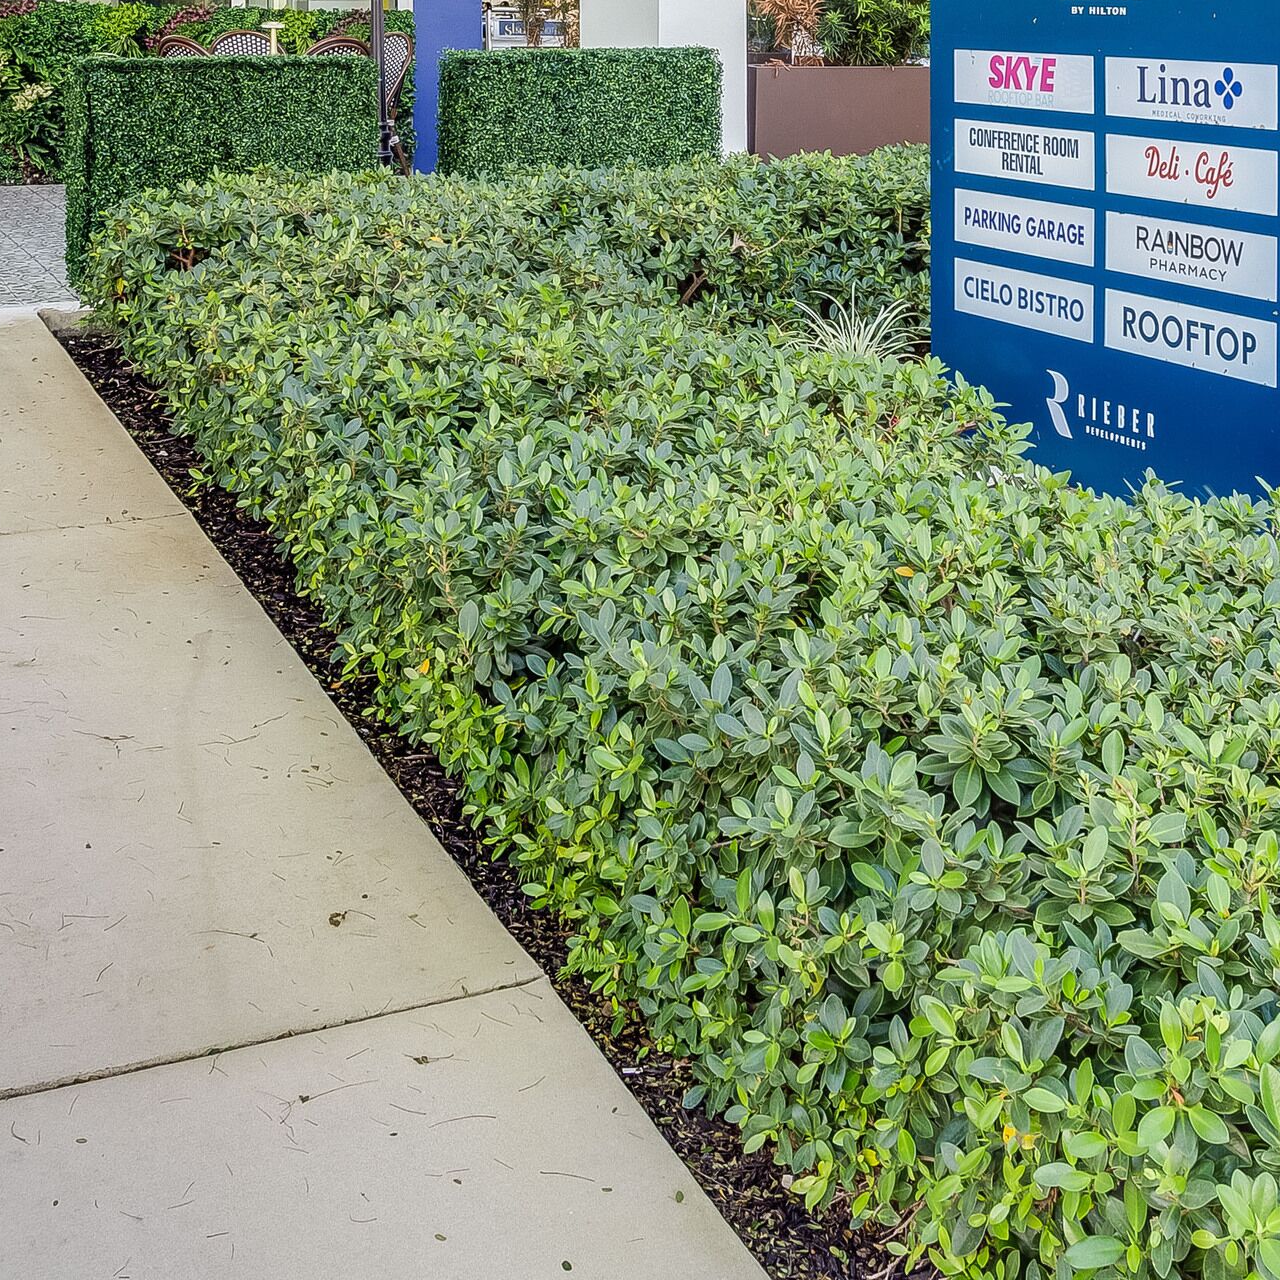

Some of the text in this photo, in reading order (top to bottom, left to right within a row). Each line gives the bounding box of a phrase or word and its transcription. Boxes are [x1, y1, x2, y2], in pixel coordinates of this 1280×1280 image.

[1071, 6, 1127, 17] BY HILTON
[987, 54, 1057, 93] SKYE
[1136, 63, 1212, 108] Lina
[988, 90, 1055, 107] ROOFTOP BAR
[1151, 109, 1227, 123] MEDICAL COWORKING
[969, 126, 1080, 159] CONFERENCE ROOM
[1001, 151, 1044, 176] RENTAL
[1144, 145, 1234, 200] Deli Café
[964, 206, 1085, 246] PARKING GARAGE
[1136, 225, 1244, 267] RAINBOW
[1149, 257, 1227, 282] PHARMACY
[963, 276, 1084, 322] CIELO BISTRO
[1122, 306, 1257, 365] ROOFTOP
[1077, 393, 1155, 438] RIEBER
[1085, 424, 1147, 451] DEVELOPMENTS
